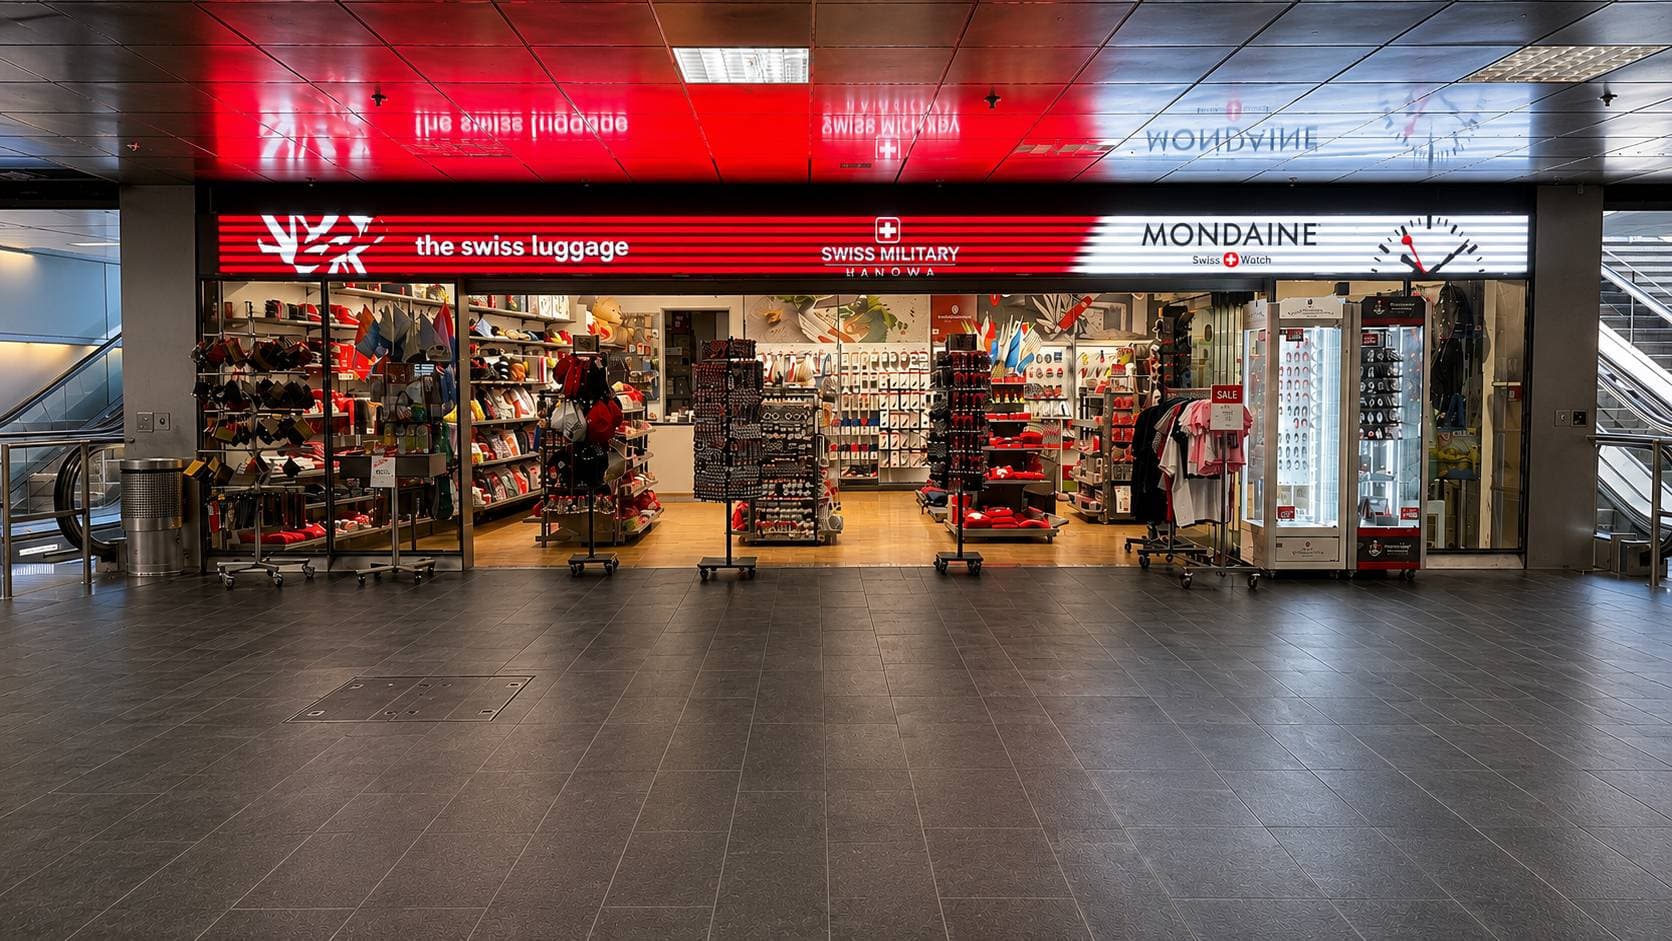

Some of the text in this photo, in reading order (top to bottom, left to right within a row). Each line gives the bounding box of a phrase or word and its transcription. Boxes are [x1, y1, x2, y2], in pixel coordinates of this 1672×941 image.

[1142, 222, 1317, 247] MONDAINE
[415, 235, 629, 262] the swiss luggage
[821, 246, 960, 261] SWISS MILITARY
[1192, 255, 1272, 265] Swiss Watch
[846, 267, 935, 277] HANOWA
[1216, 390, 1238, 400] SALE
